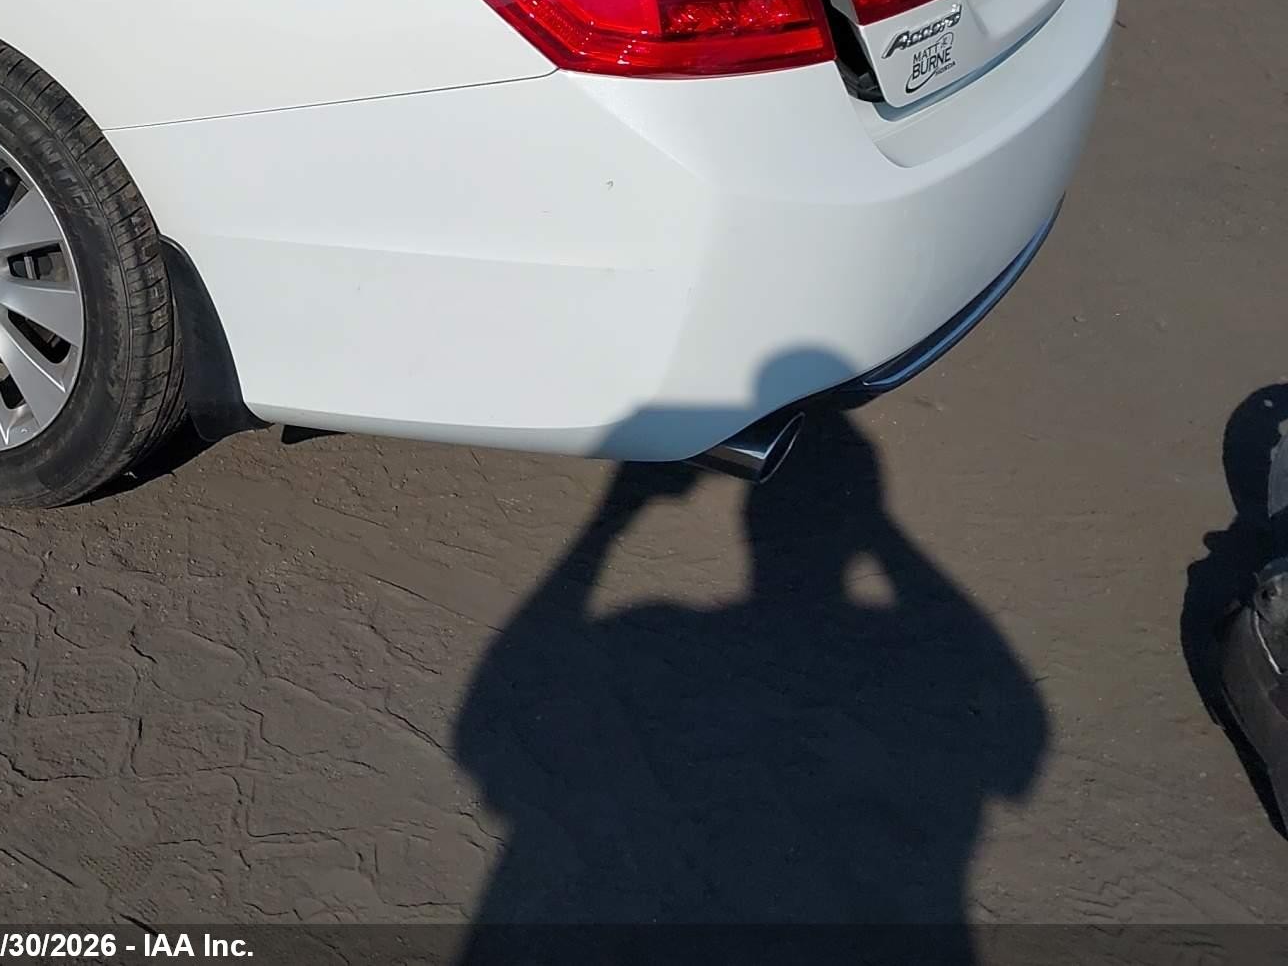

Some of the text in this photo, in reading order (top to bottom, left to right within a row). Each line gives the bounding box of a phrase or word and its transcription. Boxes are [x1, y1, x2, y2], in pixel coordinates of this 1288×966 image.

[881, 4, 962, 59] Accord
[912, 46, 953, 80] BURNE
[913, 42, 940, 64] MATT
